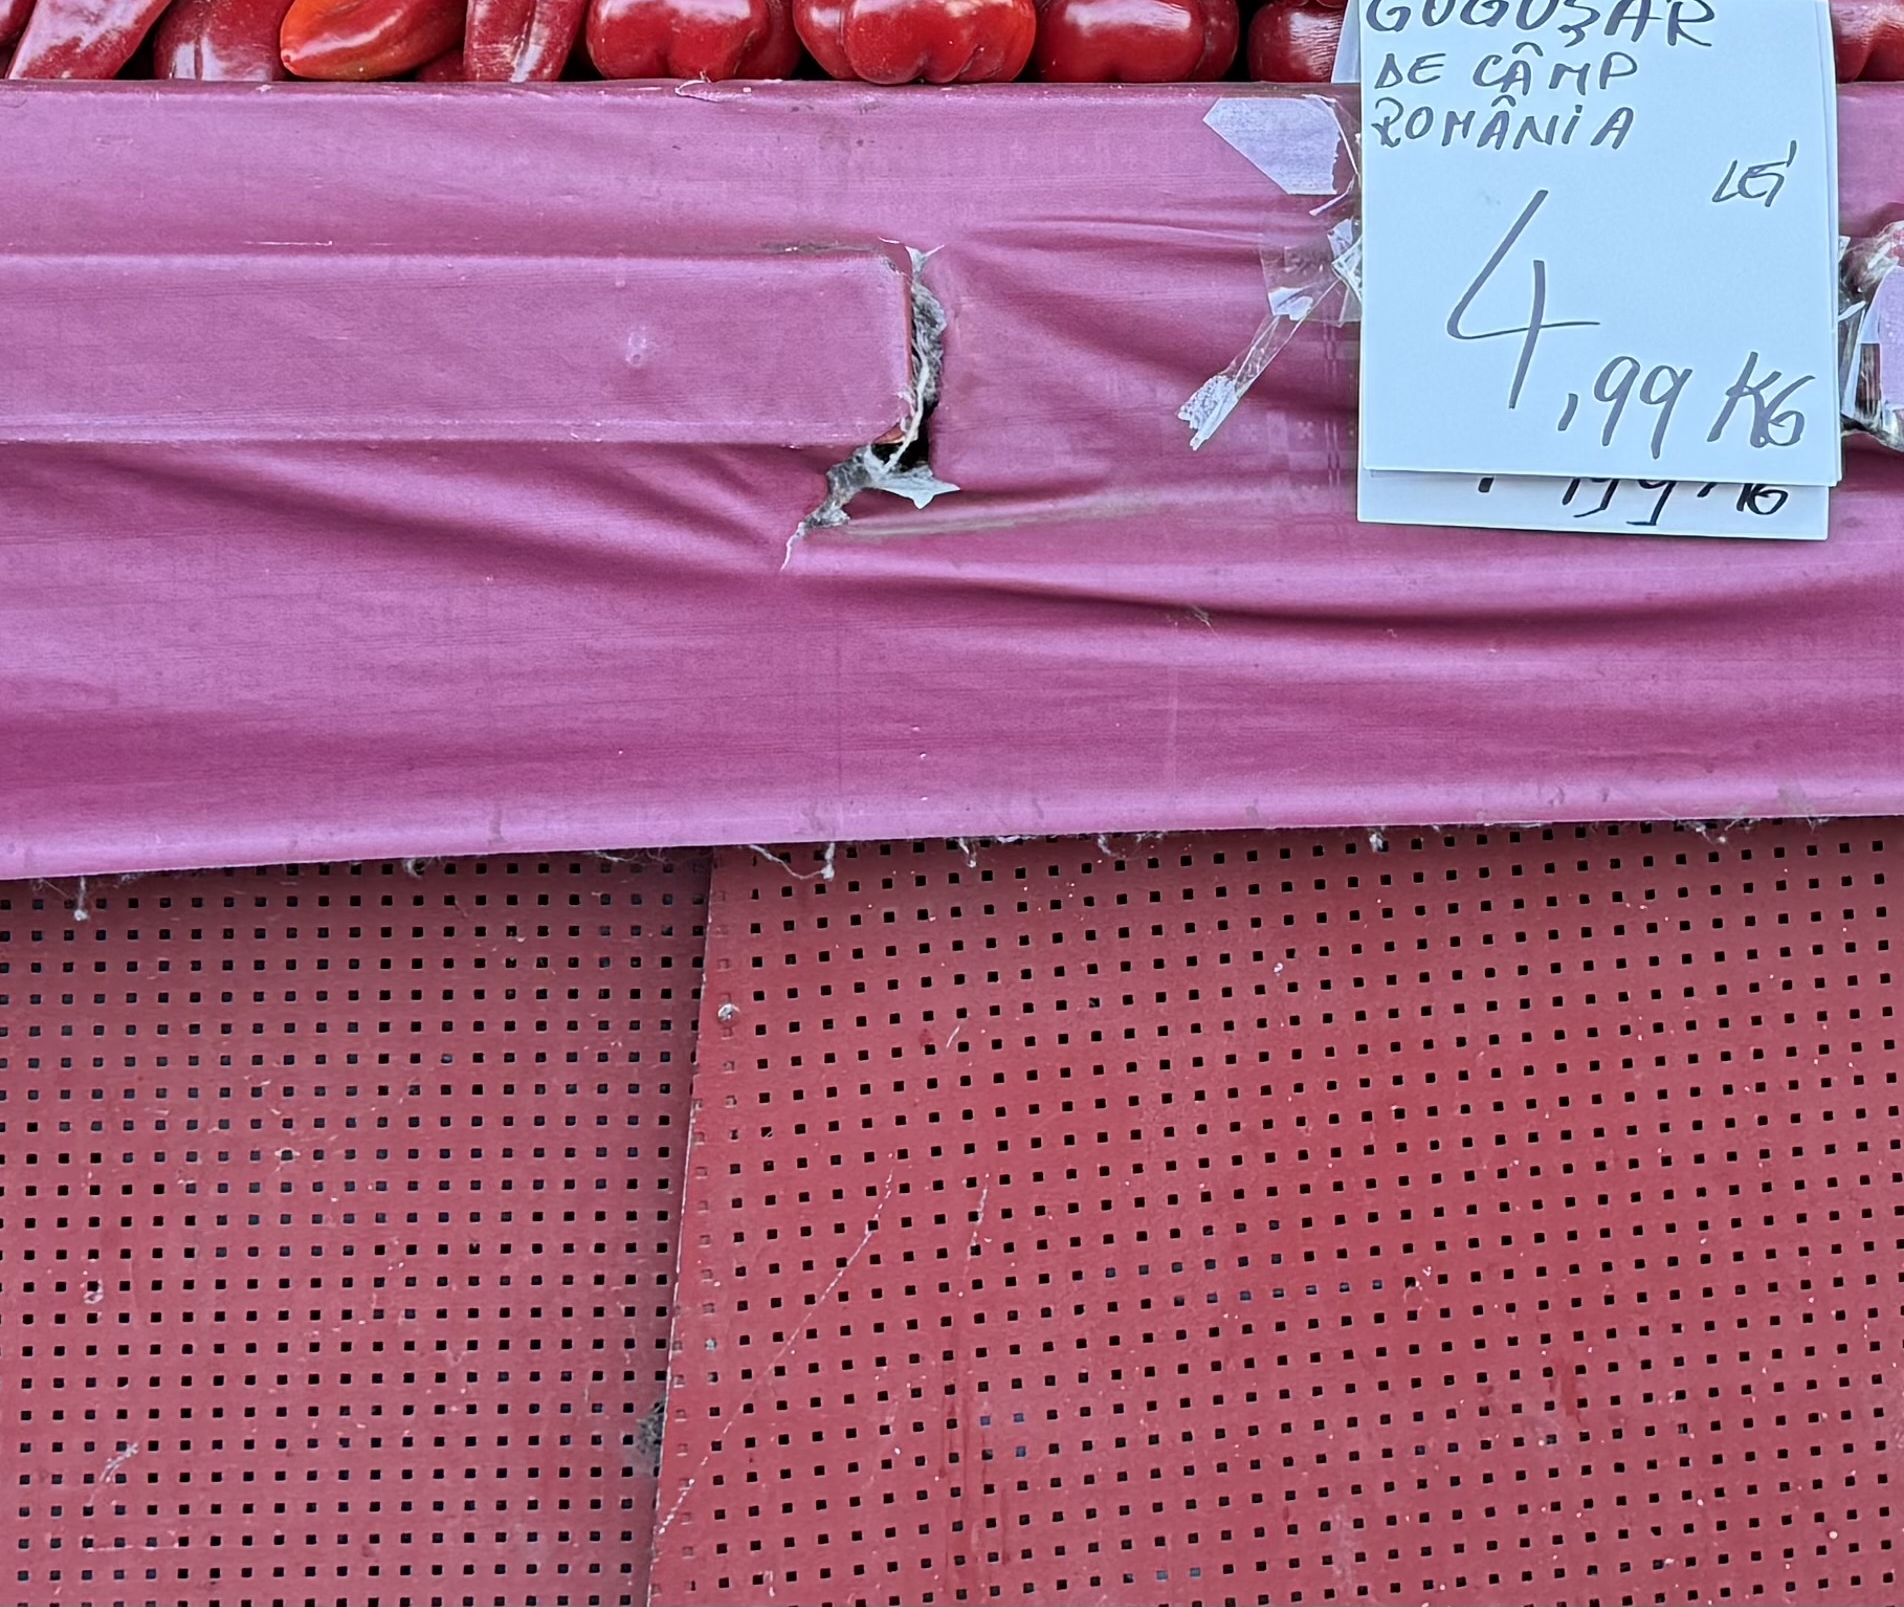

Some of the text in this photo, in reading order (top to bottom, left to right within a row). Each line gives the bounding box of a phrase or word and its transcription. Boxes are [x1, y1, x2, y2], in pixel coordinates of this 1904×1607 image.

[1375, 43, 1638, 94] DE CÂMP
[1447, 189, 1693, 459] 4,99
